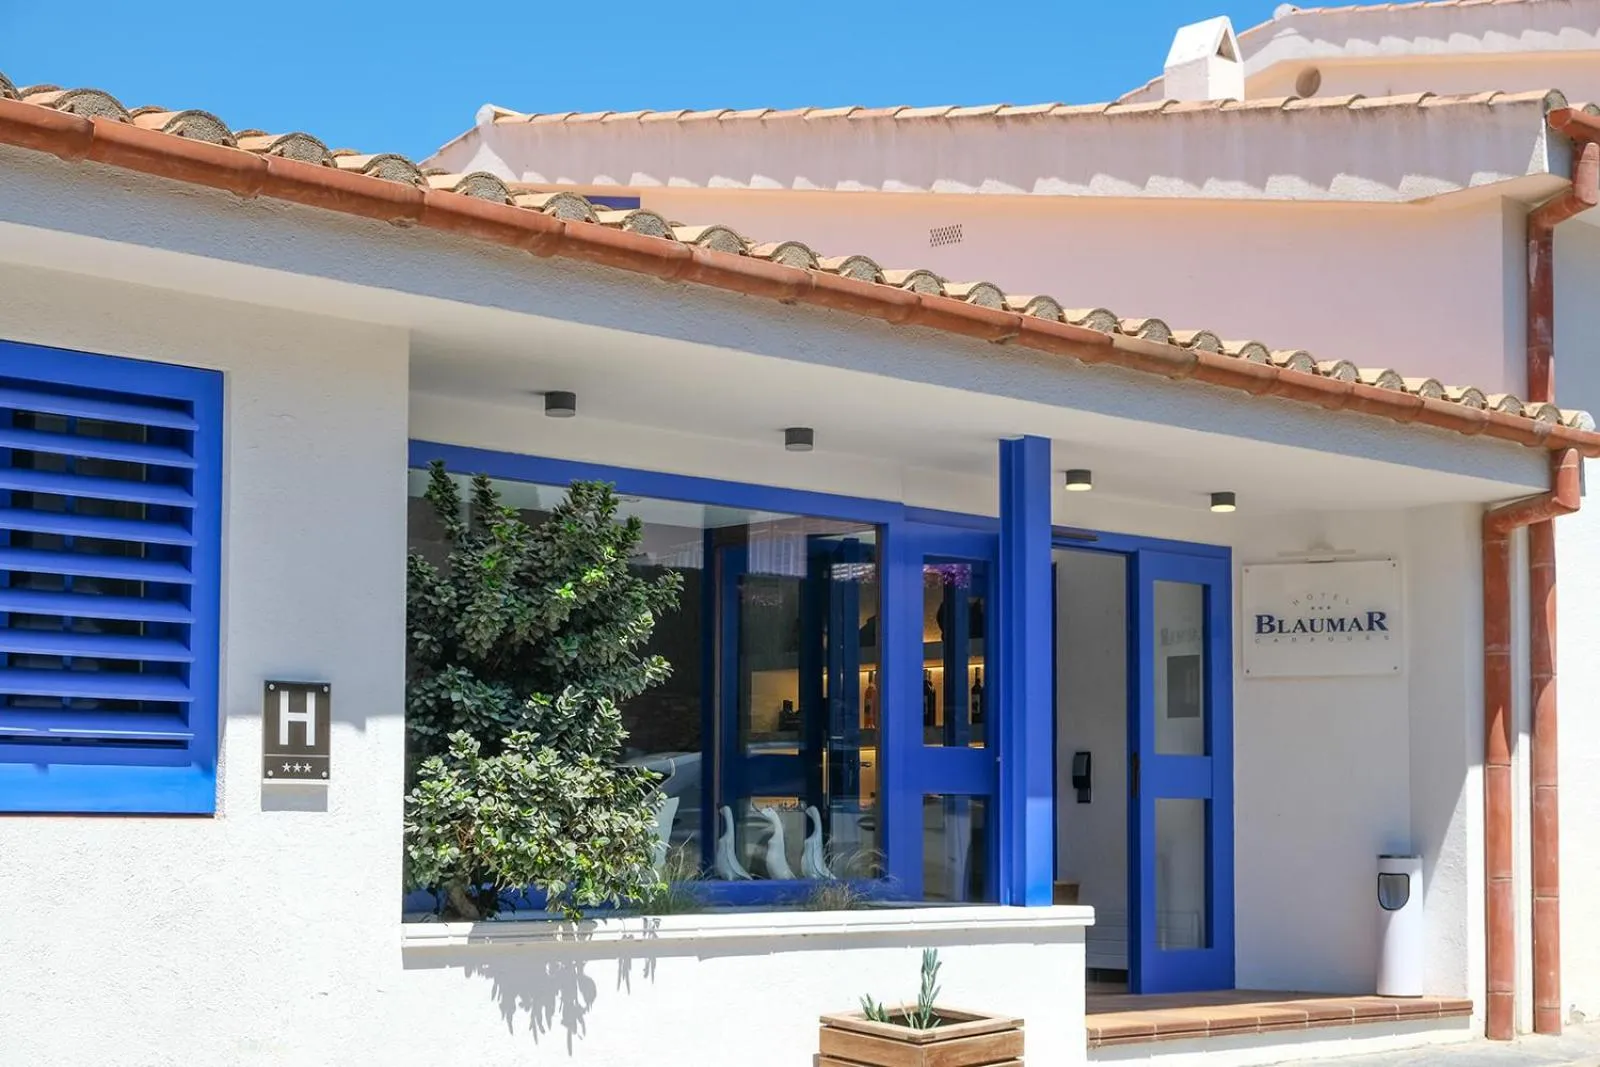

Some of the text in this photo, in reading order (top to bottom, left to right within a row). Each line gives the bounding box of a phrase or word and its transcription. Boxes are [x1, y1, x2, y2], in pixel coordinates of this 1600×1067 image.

[1292, 593, 1350, 606] HOTEL
[1255, 611, 1388, 634] BLAUMAR
[279, 690, 316, 746] H
